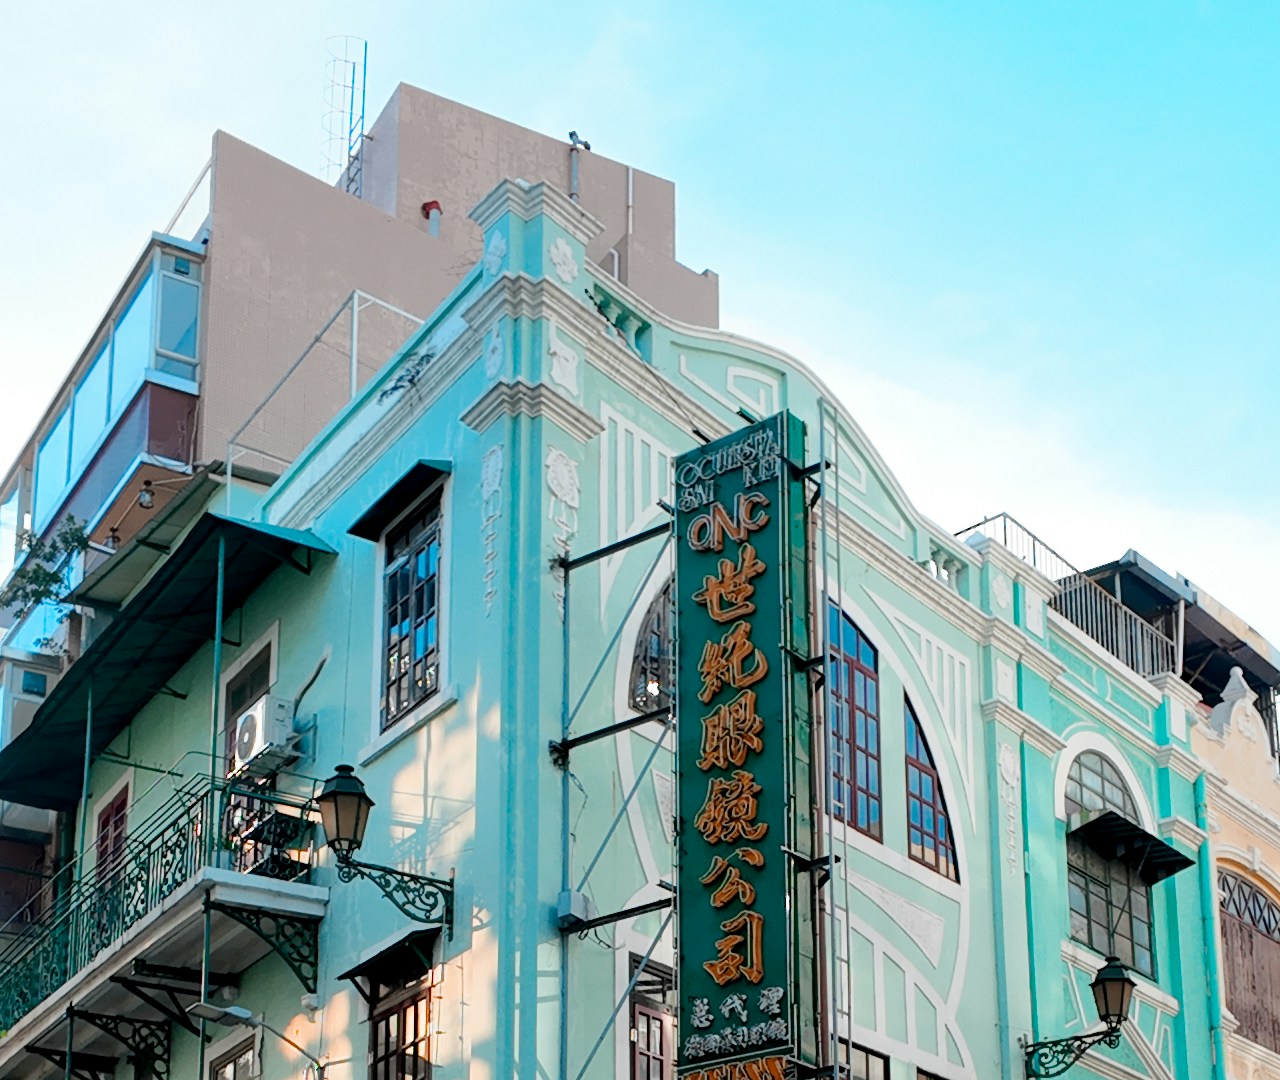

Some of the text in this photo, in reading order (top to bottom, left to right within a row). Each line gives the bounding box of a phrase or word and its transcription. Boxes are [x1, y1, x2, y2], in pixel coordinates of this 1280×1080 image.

[687, 491, 771, 552] ONC
[691, 541, 769, 987] 世紀眼鏡公司
